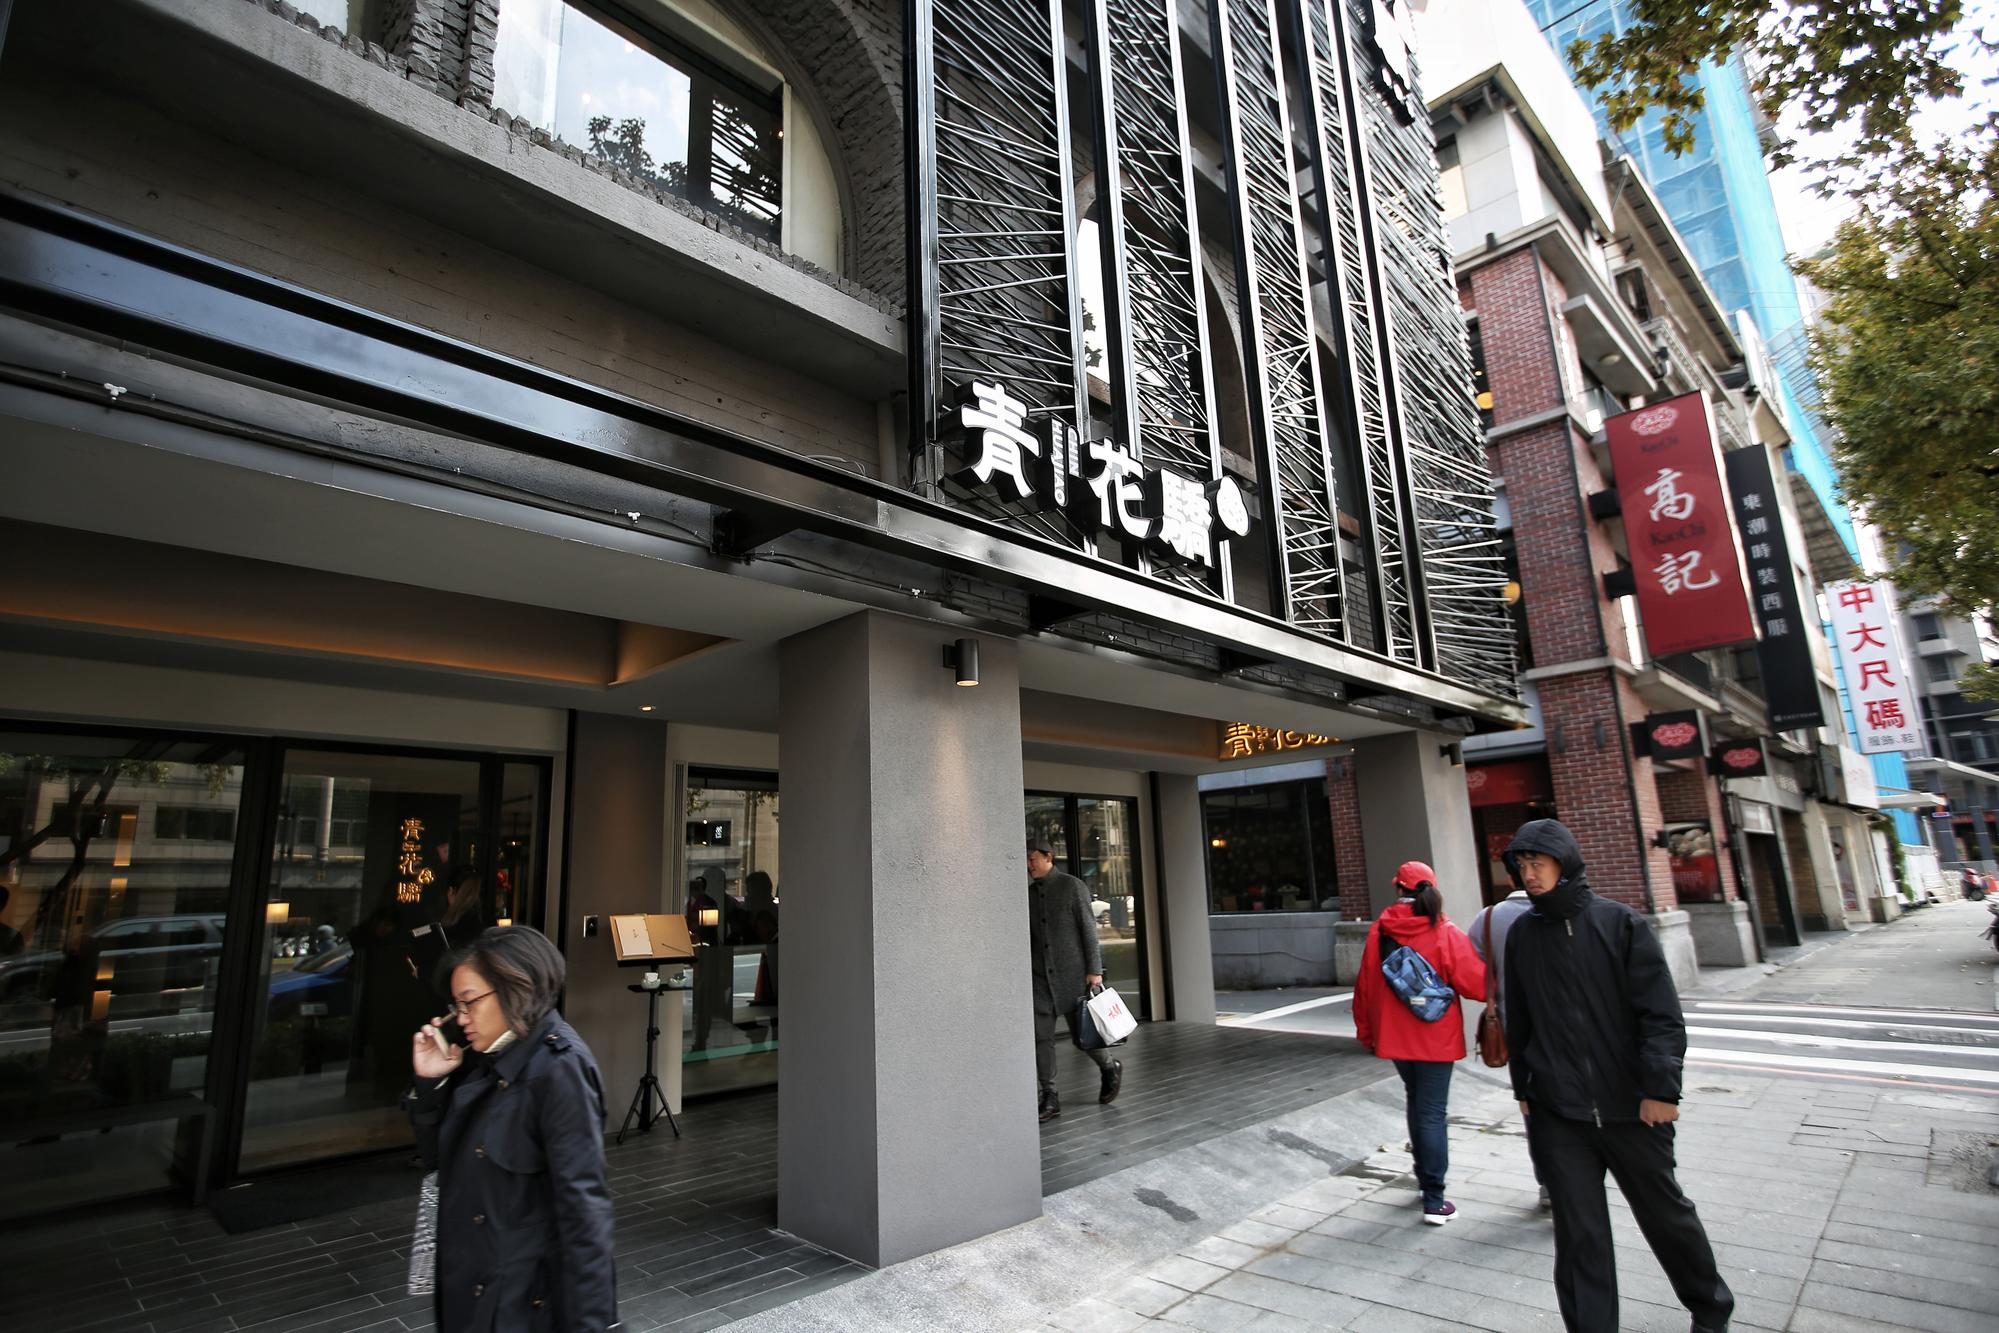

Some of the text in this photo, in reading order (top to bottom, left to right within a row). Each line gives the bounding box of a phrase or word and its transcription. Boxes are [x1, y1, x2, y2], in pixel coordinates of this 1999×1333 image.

[1068, 427, 1080, 477] CHIN
[1644, 467, 1720, 595] 高記
[1839, 585, 1905, 730] 中大尺碼
